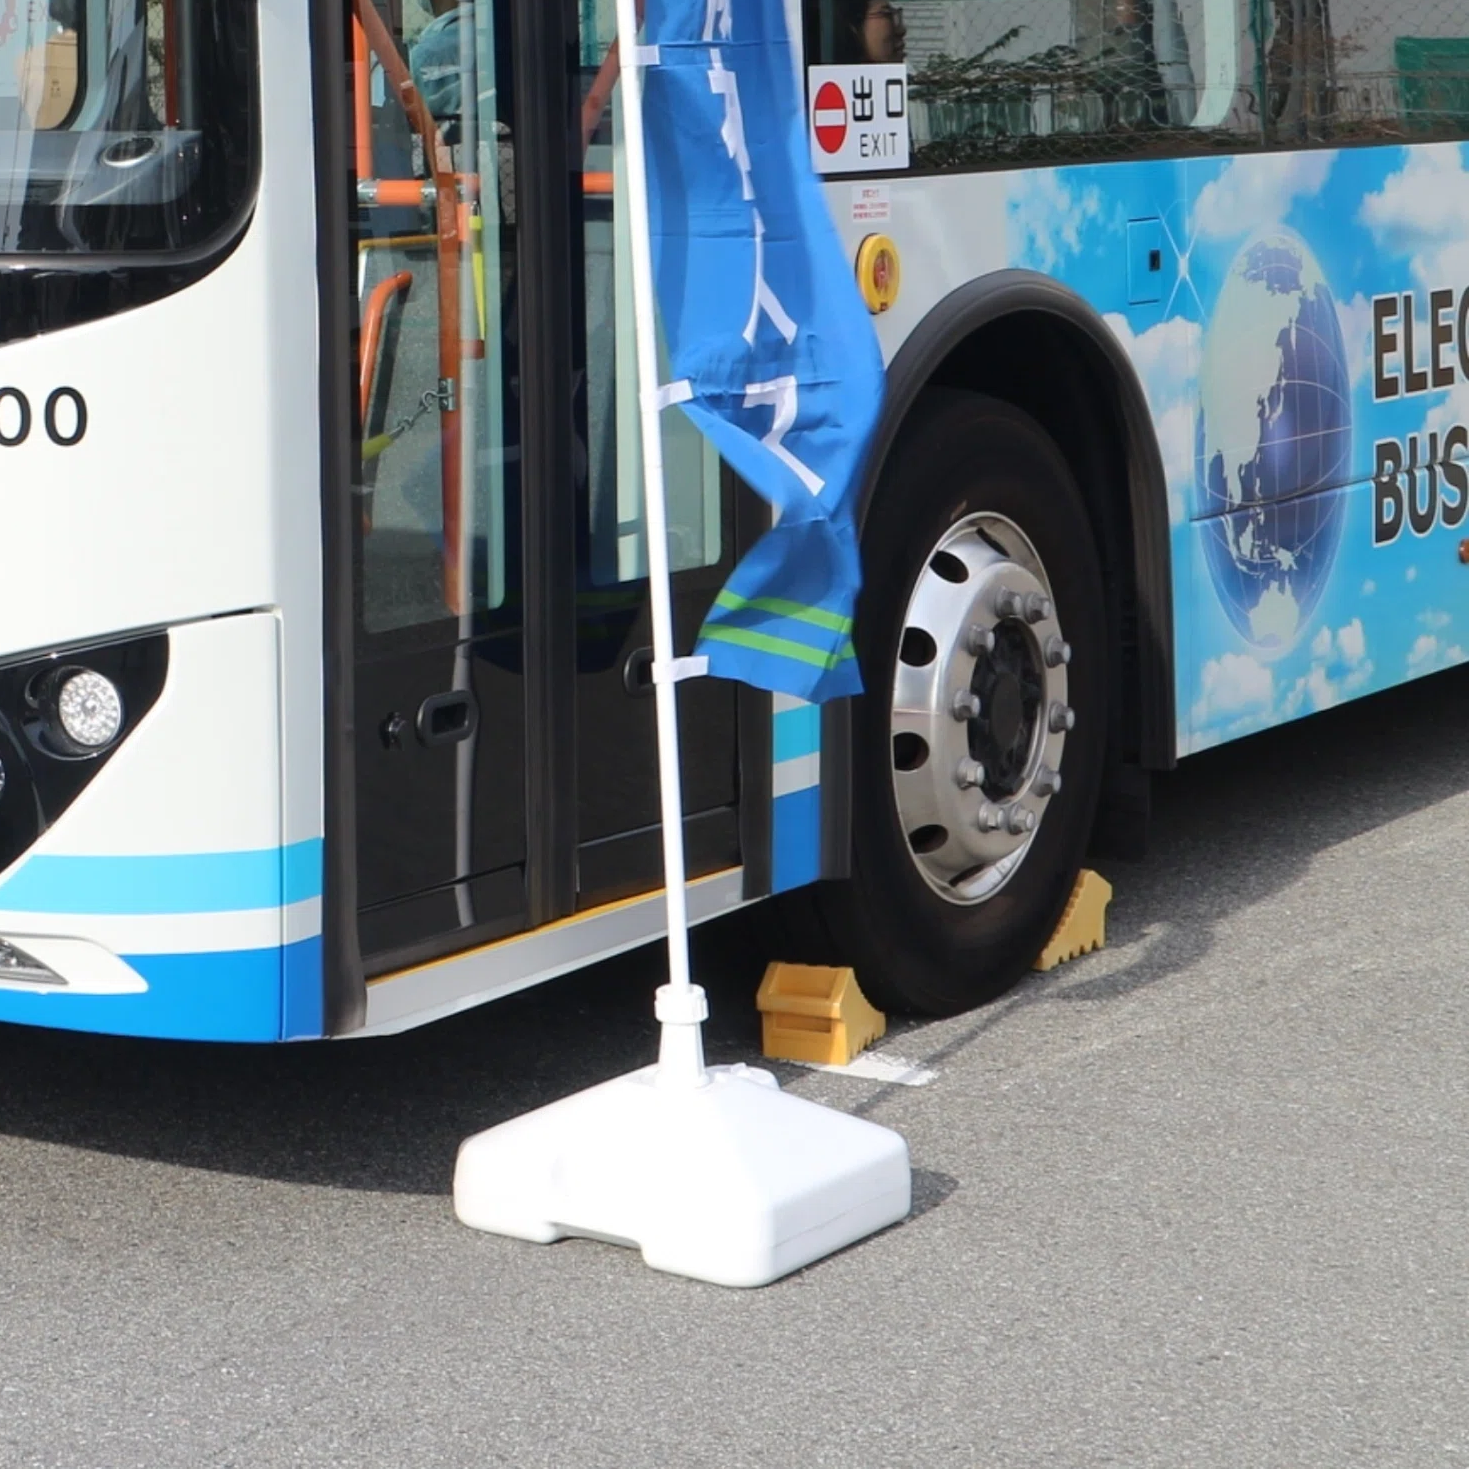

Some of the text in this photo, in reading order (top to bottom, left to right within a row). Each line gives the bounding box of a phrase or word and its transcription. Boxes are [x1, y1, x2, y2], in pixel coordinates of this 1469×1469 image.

[852, 75, 904, 123] 出口
[860, 132, 897, 158] EXIT
[1374, 425, 1469, 546] BUS
